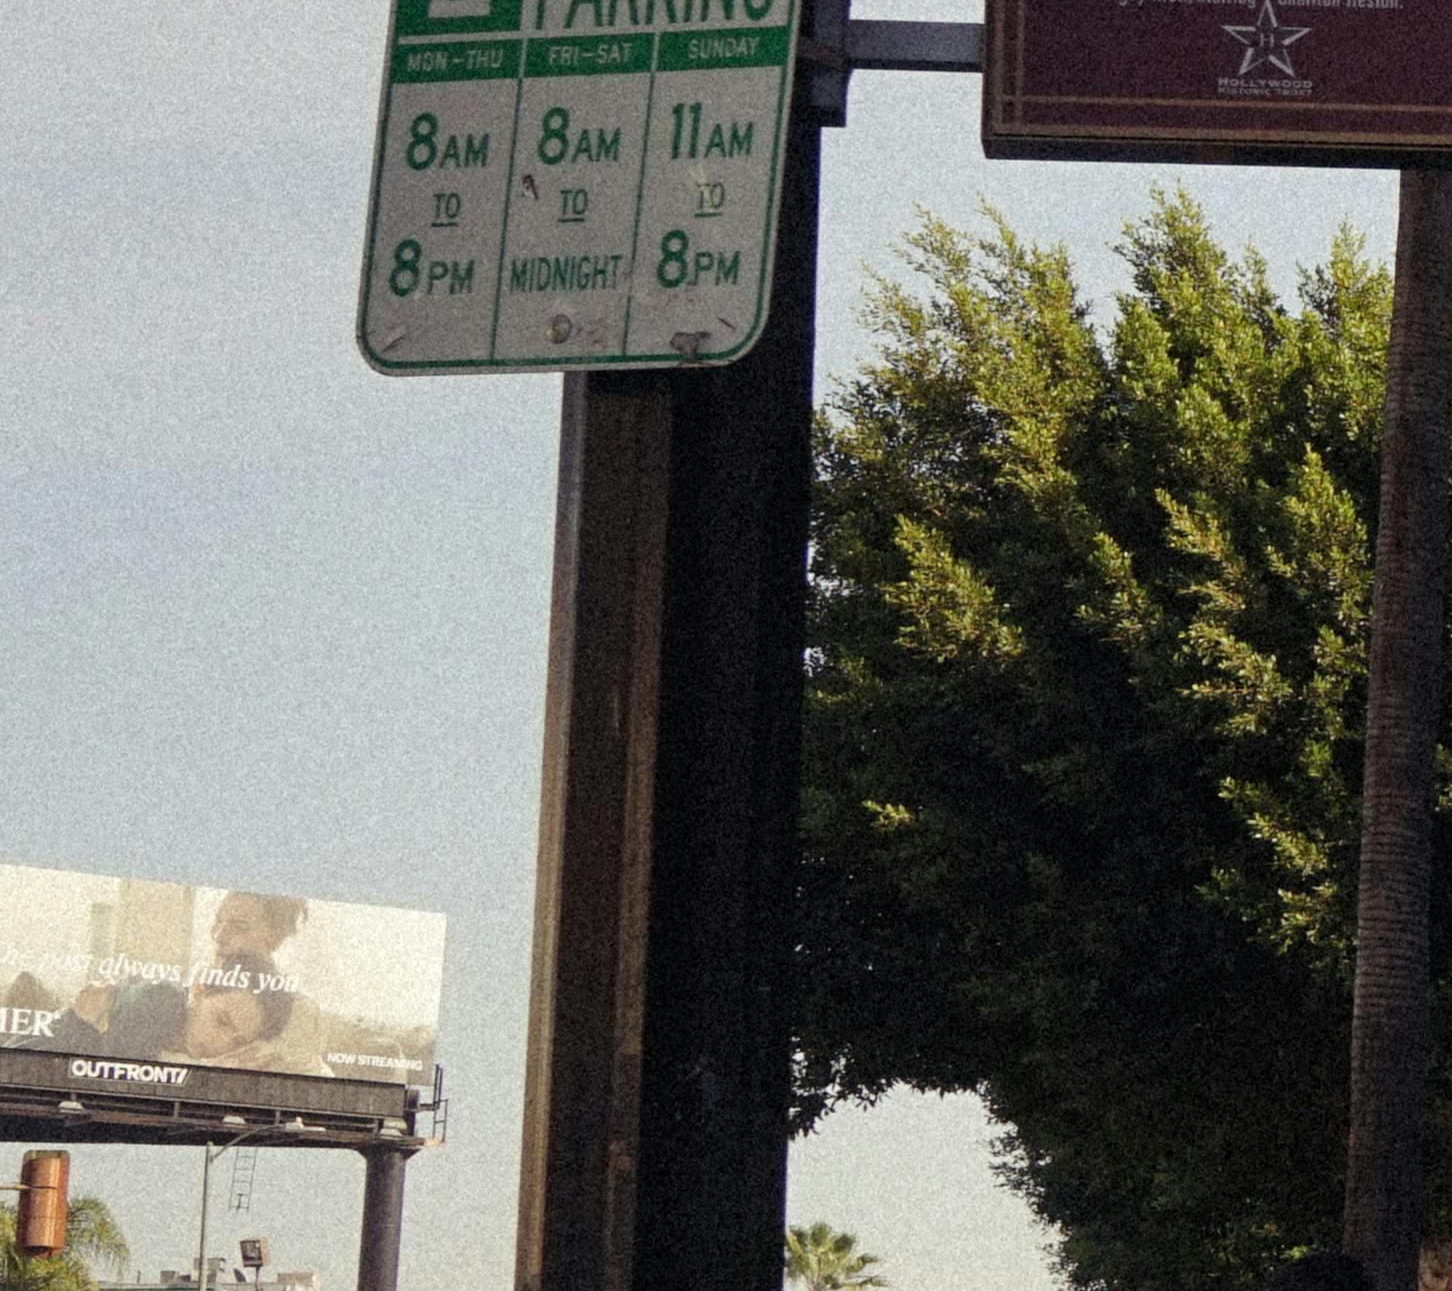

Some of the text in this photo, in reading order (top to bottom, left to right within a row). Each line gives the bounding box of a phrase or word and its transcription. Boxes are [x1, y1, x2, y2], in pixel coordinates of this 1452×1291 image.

[688, 37, 760, 60] SUNDAY
[1218, 77, 1313, 89] HOLLYWOOD
[431, 183, 726, 226] TO TO TO
[509, 254, 623, 292] MIDNIGHT
[99, 953, 182, 983] always
[187, 963, 250, 989] finds
[71, 1060, 178, 1084] OUTFRONT
[327, 1051, 423, 1072] NOW STREAMING
